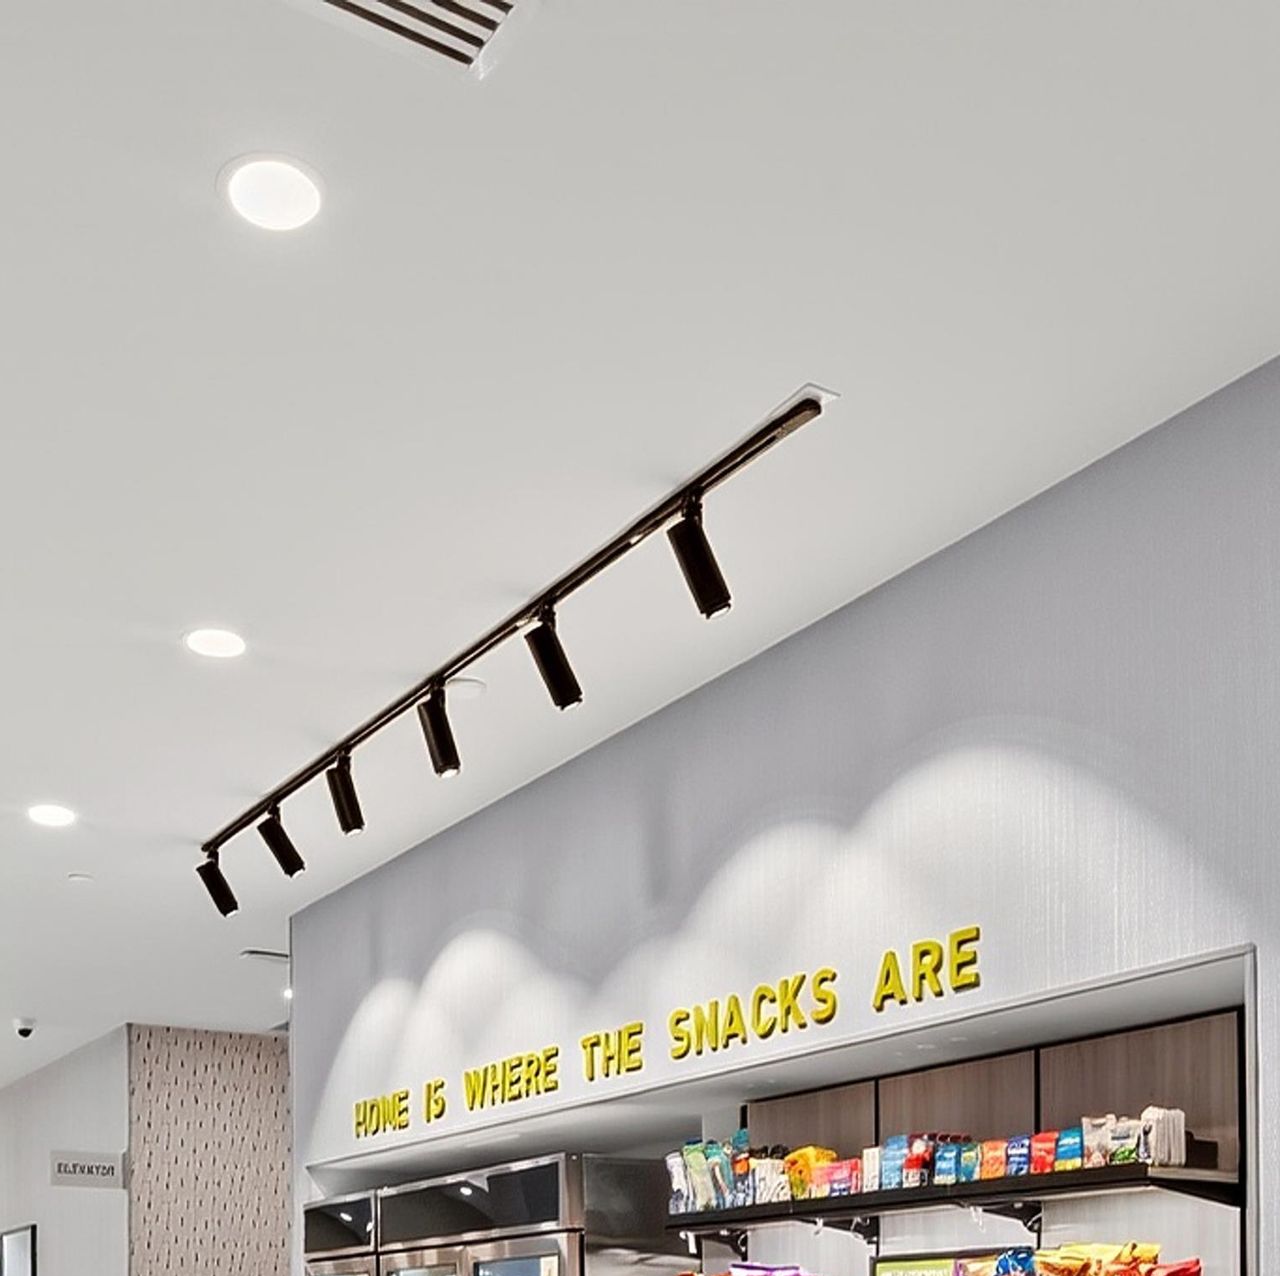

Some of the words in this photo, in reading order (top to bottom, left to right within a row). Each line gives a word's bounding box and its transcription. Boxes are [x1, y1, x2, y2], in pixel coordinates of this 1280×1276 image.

[354, 1090, 409, 1138] HOME
[424, 1078, 446, 1123] IS
[463, 1046, 559, 1111] WHERE
[580, 1020, 644, 1082] THE
[668, 967, 839, 1060] SNACKS
[872, 926, 982, 1013] ARE
